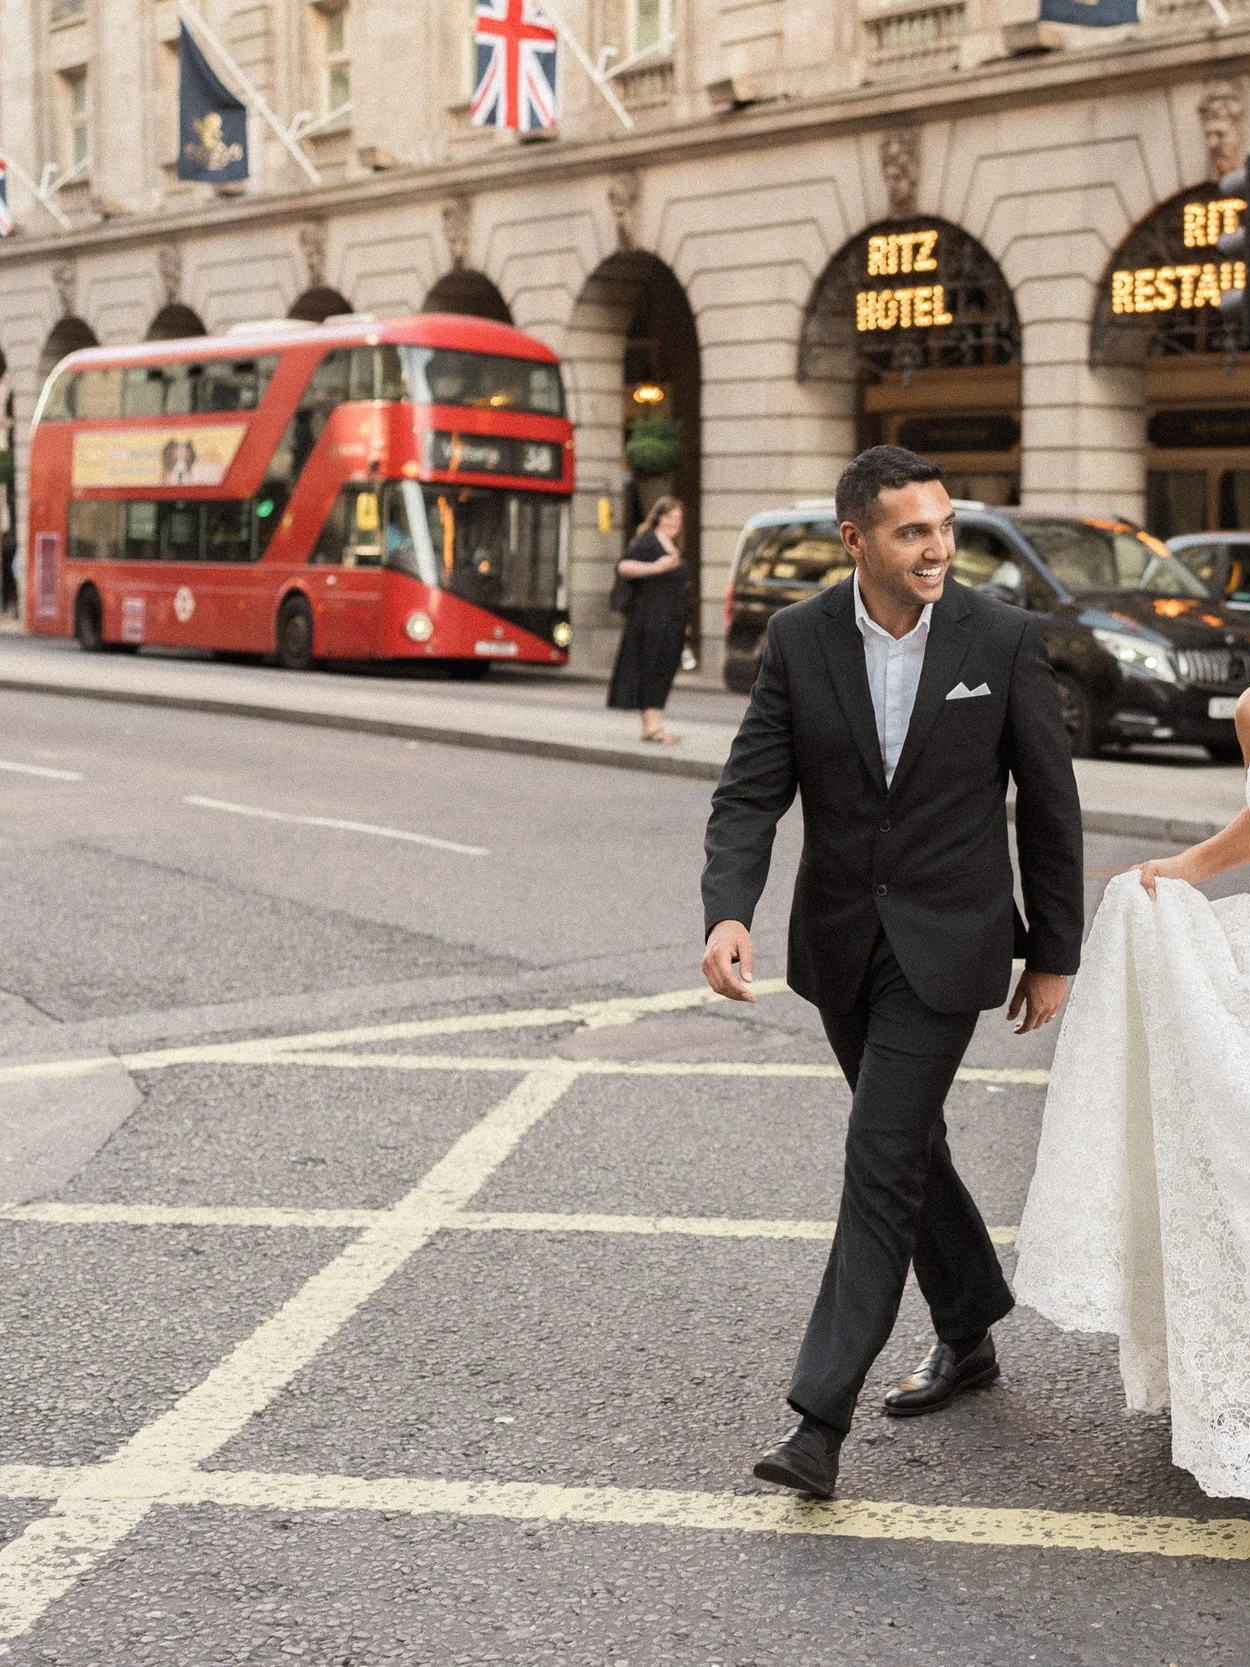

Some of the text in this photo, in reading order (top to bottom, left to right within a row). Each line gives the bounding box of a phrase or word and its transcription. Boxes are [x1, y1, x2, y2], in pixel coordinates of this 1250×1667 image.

[1183, 198, 1248, 248] RIT
[867, 230, 938, 276] RITZ
[856, 285, 953, 331] HOTEL
